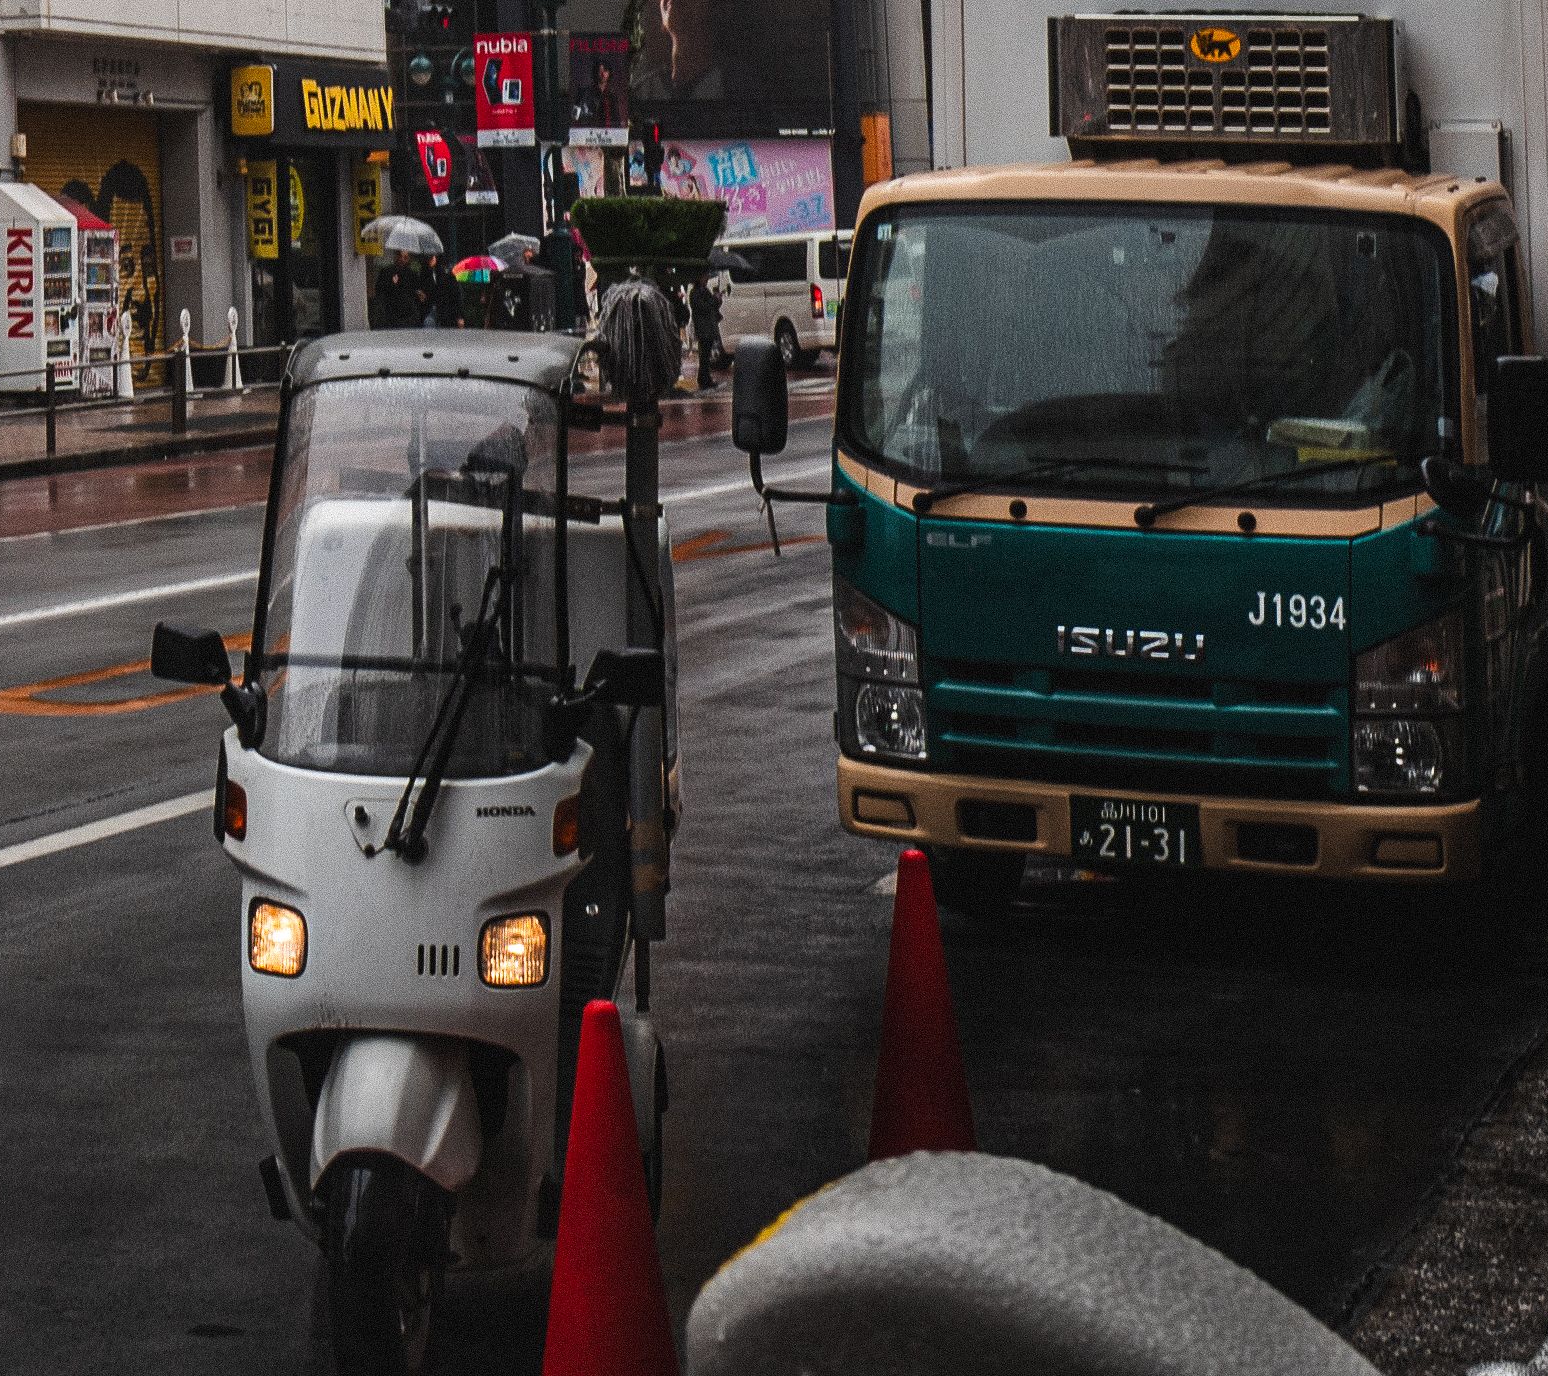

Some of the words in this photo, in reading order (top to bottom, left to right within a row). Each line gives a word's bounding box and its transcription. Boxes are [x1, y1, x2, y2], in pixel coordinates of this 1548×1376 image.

[475, 36, 529, 55] nubia
[301, 77, 383, 132] GUZMAN
[379, 85, 395, 132] Y
[251, 177, 274, 246] GYG!
[6, 228, 35, 339] KIRIN
[1247, 590, 1348, 631] J1934
[1056, 624, 1206, 661] ISUZU
[476, 805, 536, 818] HONDA
[1099, 800, 1137, 822] 品川
[1140, 803, 1167, 824] 101
[1098, 823, 1186, 865] 21-31
